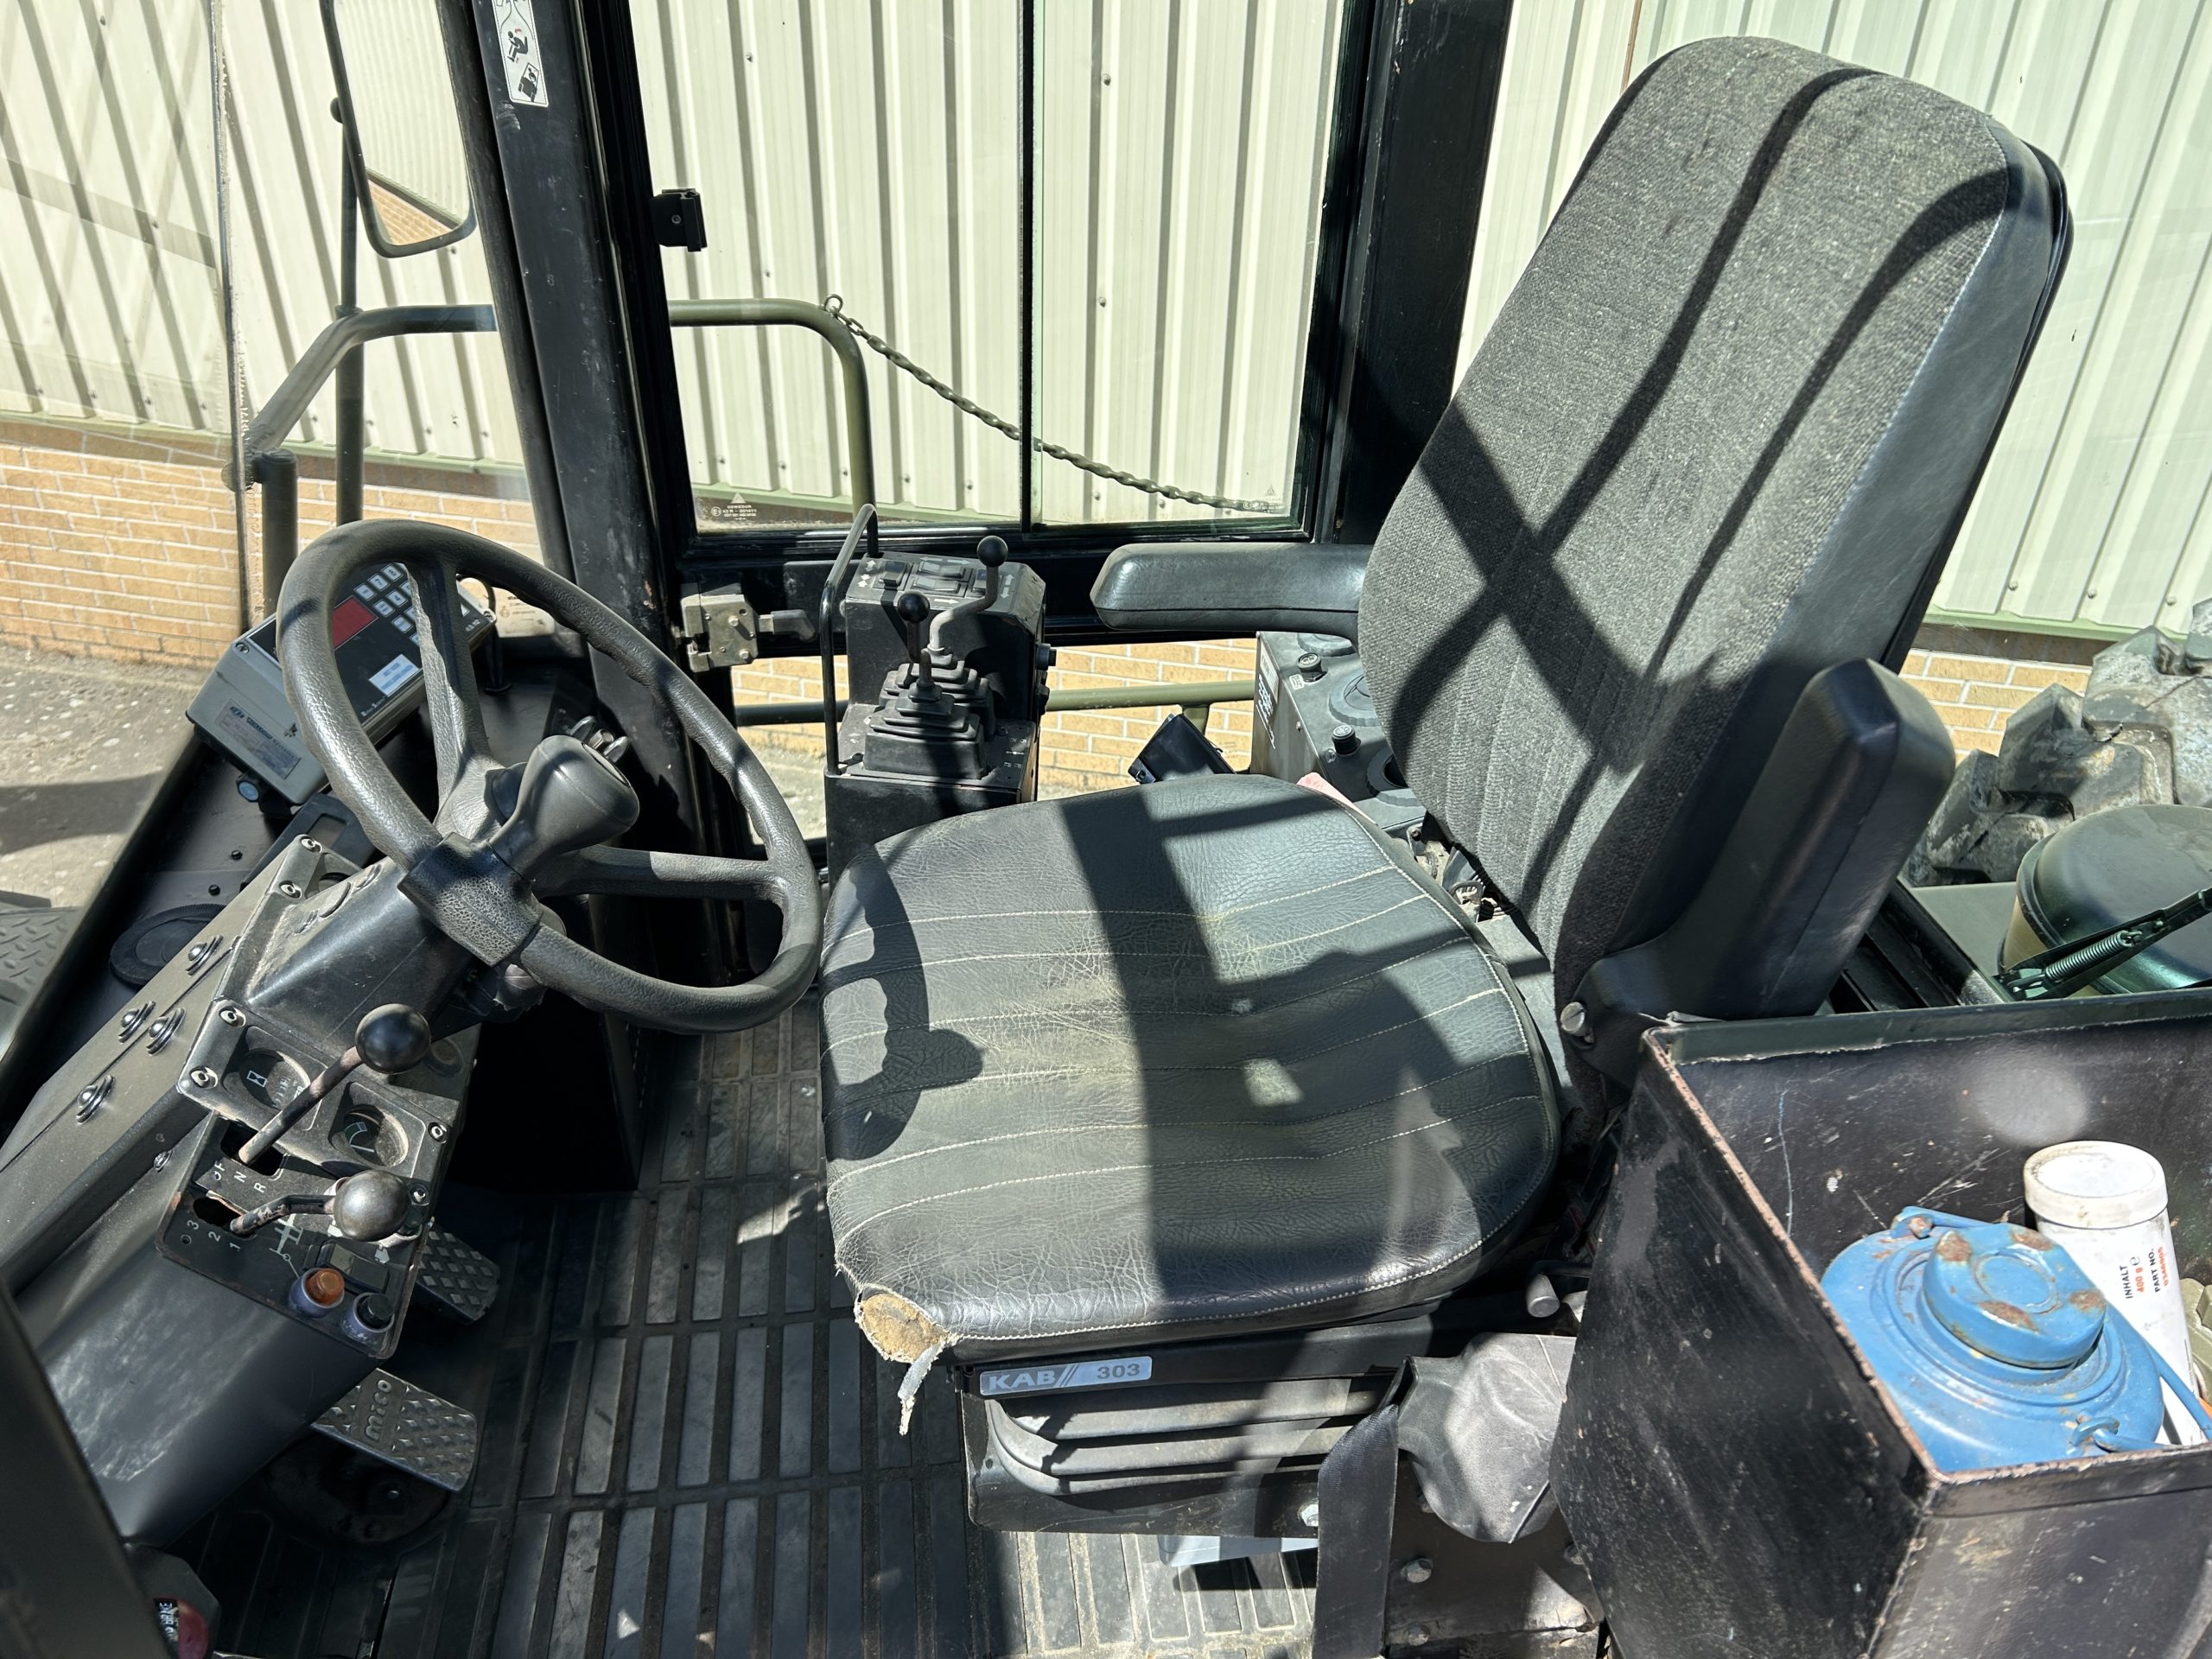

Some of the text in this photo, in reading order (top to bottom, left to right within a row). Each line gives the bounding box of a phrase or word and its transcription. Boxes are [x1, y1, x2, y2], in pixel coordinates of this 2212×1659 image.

[214, 1160, 225, 1171] F
[234, 1171, 247, 1183] N
[253, 1182, 266, 1193] R
[187, 1220, 199, 1230] 3
[208, 1231, 221, 1242] 2
[2148, 1248, 2161, 1293] PART NO.
[2119, 1265, 2134, 1299] INHALT
[2135, 1275, 2145, 1293] 400
[988, 1363, 1141, 1390] KAB 303
[365, 1379, 391, 1440] mico
